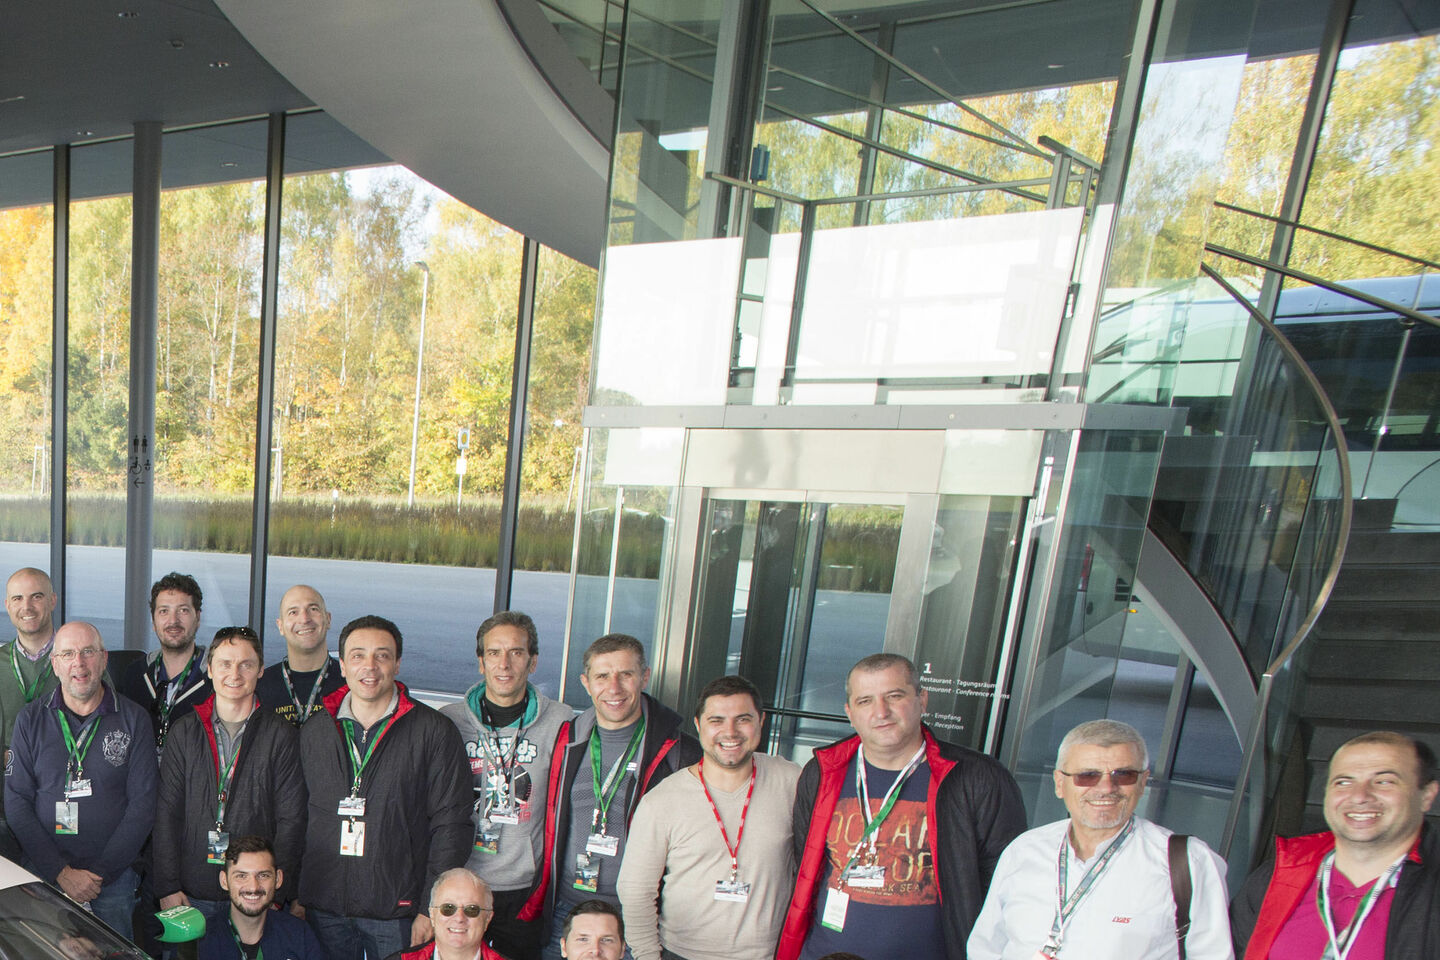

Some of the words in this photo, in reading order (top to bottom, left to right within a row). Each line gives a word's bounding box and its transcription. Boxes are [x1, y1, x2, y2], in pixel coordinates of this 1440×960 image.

[923, 662, 932, 674] 1
[920, 675, 952, 685] Restaurant
[957, 679, 997, 689] Tagungsräum
[920, 685, 952, 694] estaurant
[956, 688, 989, 697] Conference
[934, 712, 961, 722] Empfang
[934, 721, 964, 730] Reception
[900, 883, 921, 893] SEA
